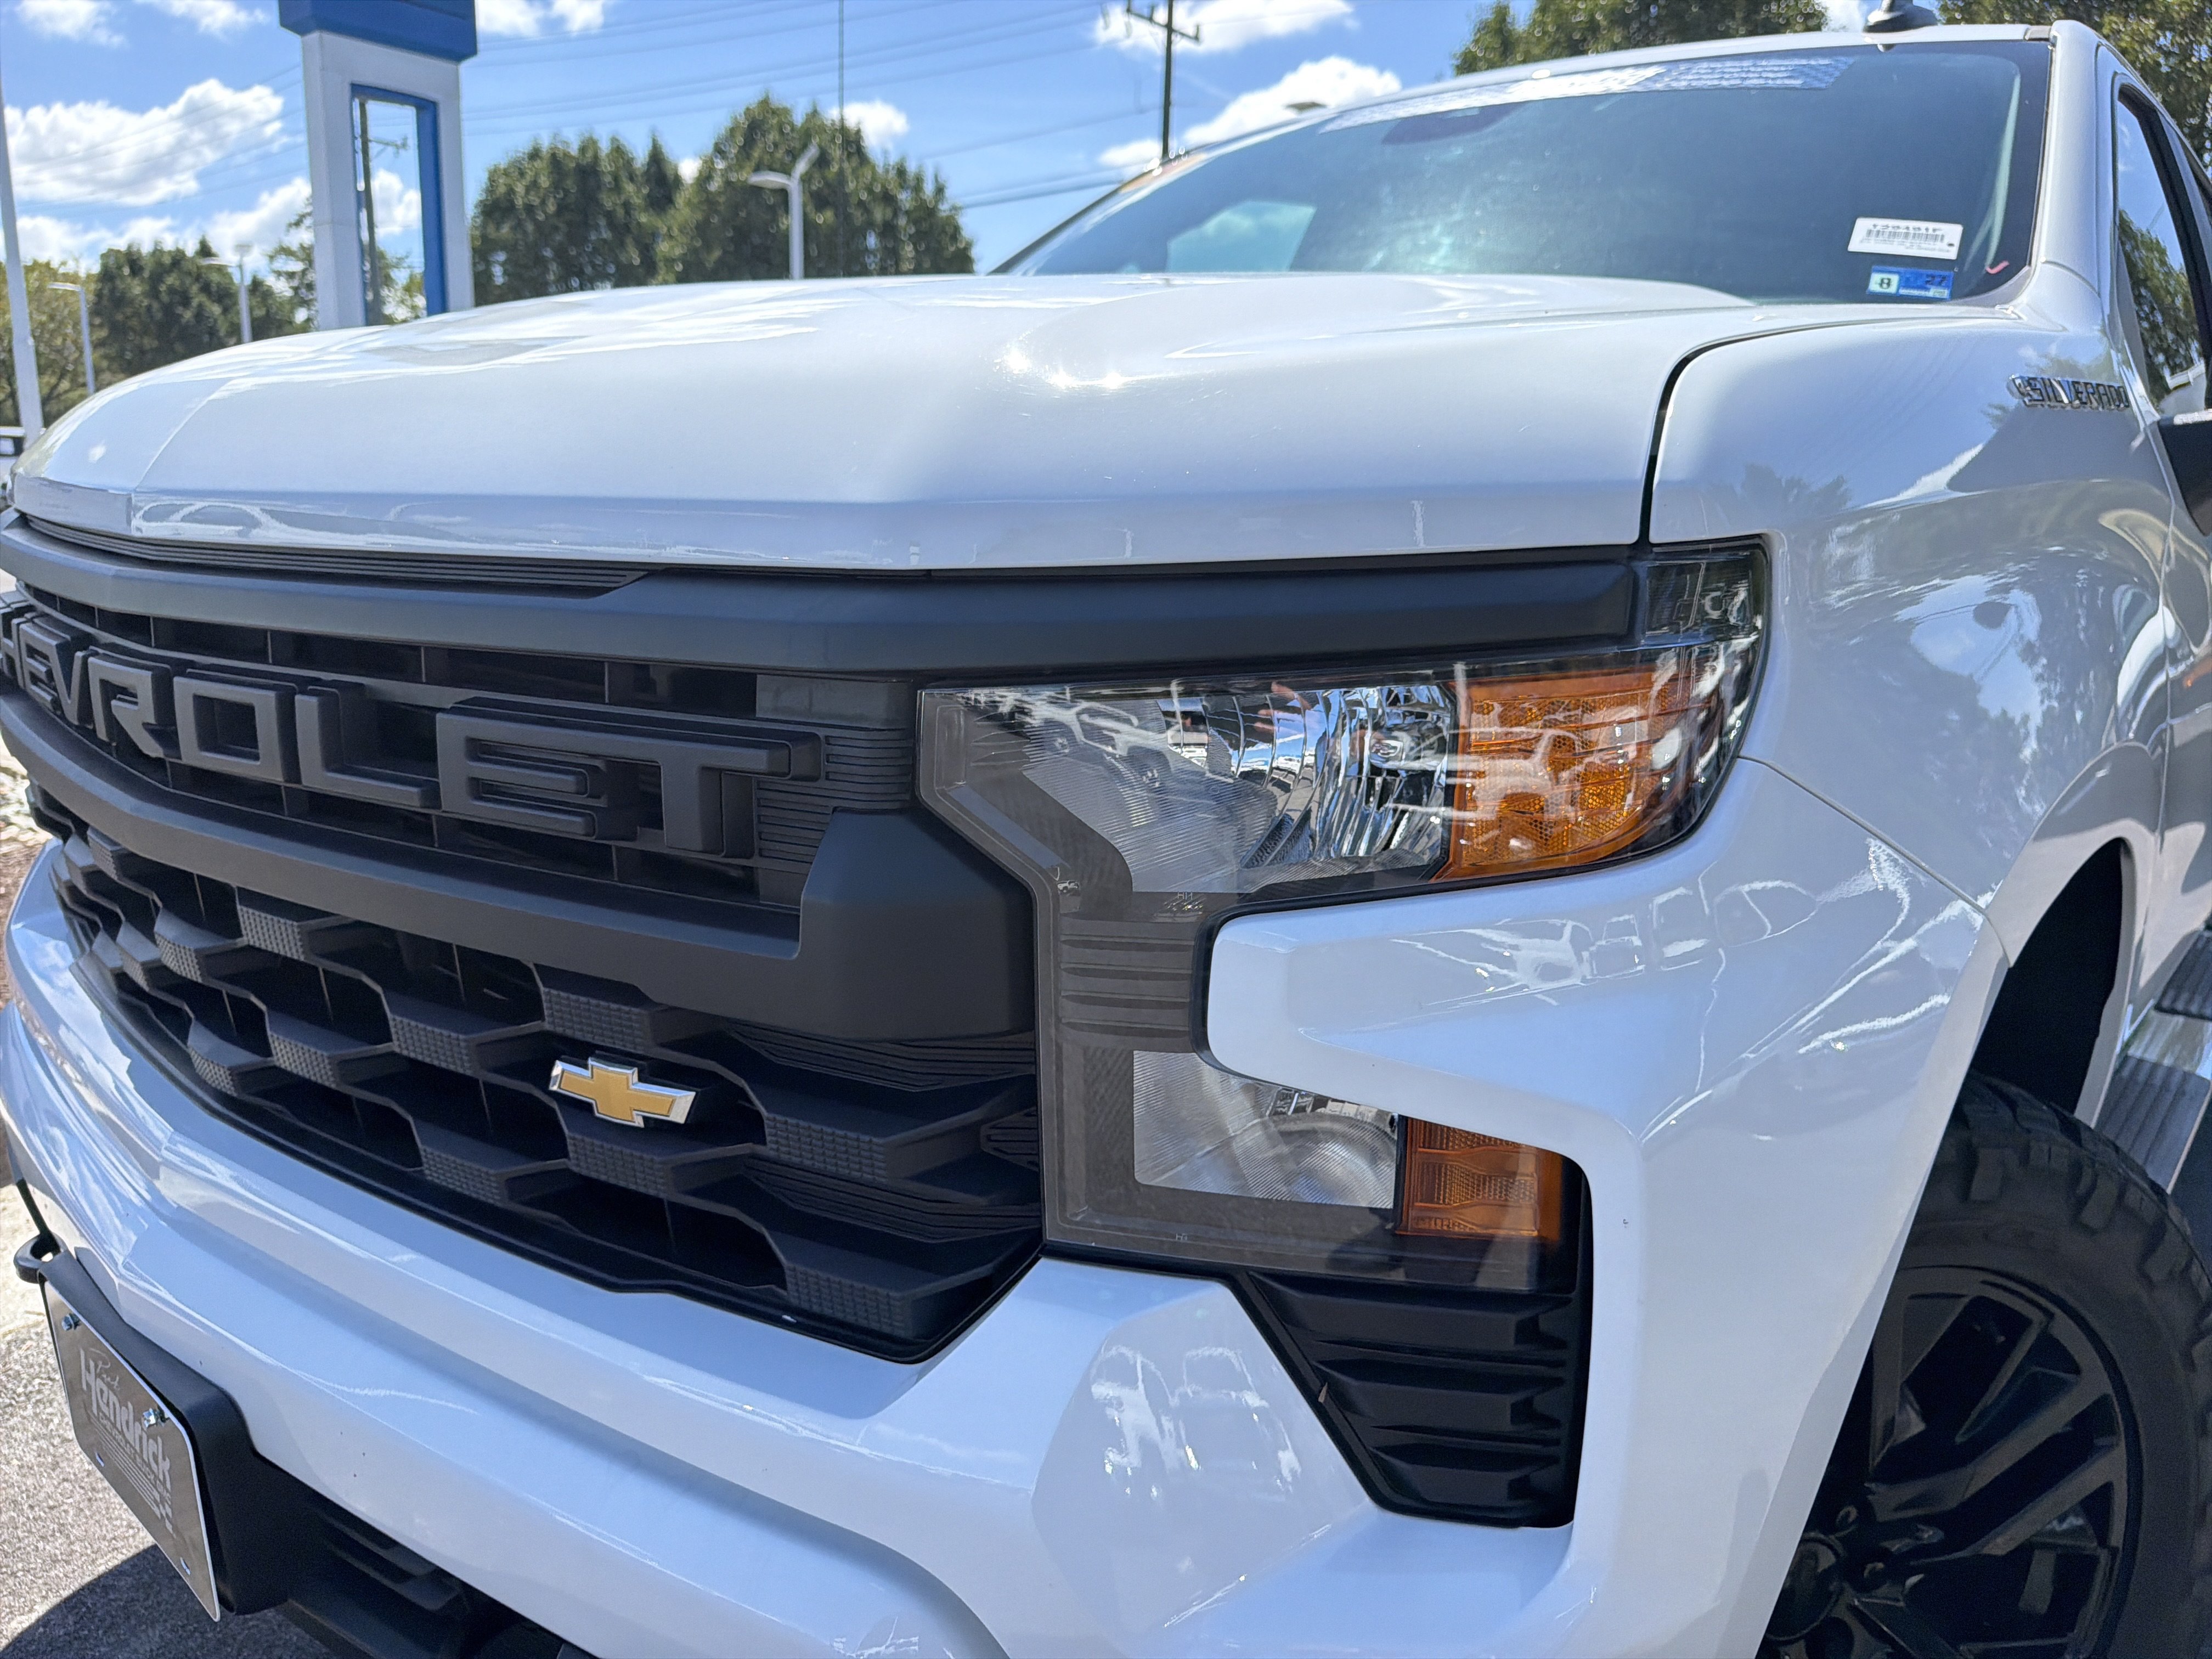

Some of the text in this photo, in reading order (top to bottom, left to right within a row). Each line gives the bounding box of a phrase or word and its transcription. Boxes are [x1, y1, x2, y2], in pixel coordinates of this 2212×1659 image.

[1879, 278, 1891, 289] 8
[2012, 375, 2130, 409] SILVERADO
[80, 1347, 171, 1493] Hendrick
